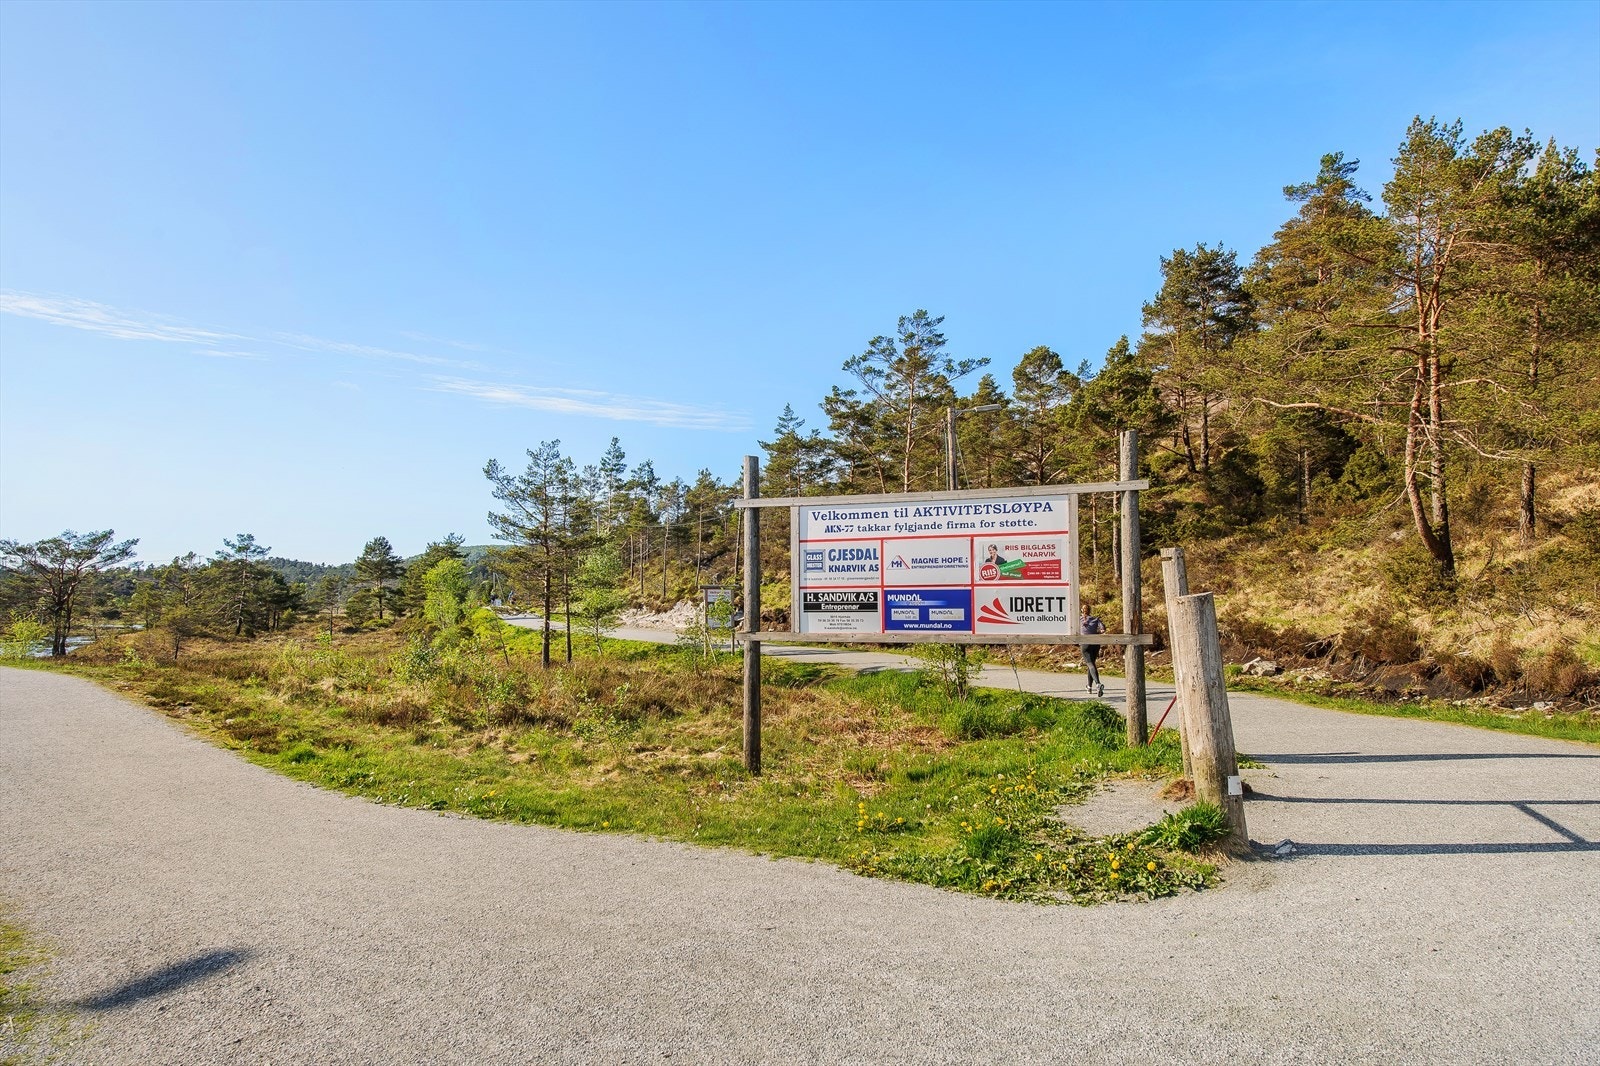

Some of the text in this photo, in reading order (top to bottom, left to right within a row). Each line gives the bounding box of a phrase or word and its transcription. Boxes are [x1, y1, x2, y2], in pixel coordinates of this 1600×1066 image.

[812, 501, 1053, 521] Velkommen til AKTIVITETSLØYPA
[824, 519, 1037, 534] AKS-77 takkar fylgjande firma for støtte.
[806, 553, 822, 561] GLASS
[828, 548, 879, 562] GJESDAL
[828, 564, 866, 573] KNARVIK
[868, 563, 879, 572] AS
[981, 568, 996, 577] RIIS
[807, 592, 874, 602] H. SANDVIK A/S
[1009, 597, 1066, 612] IDRETT
